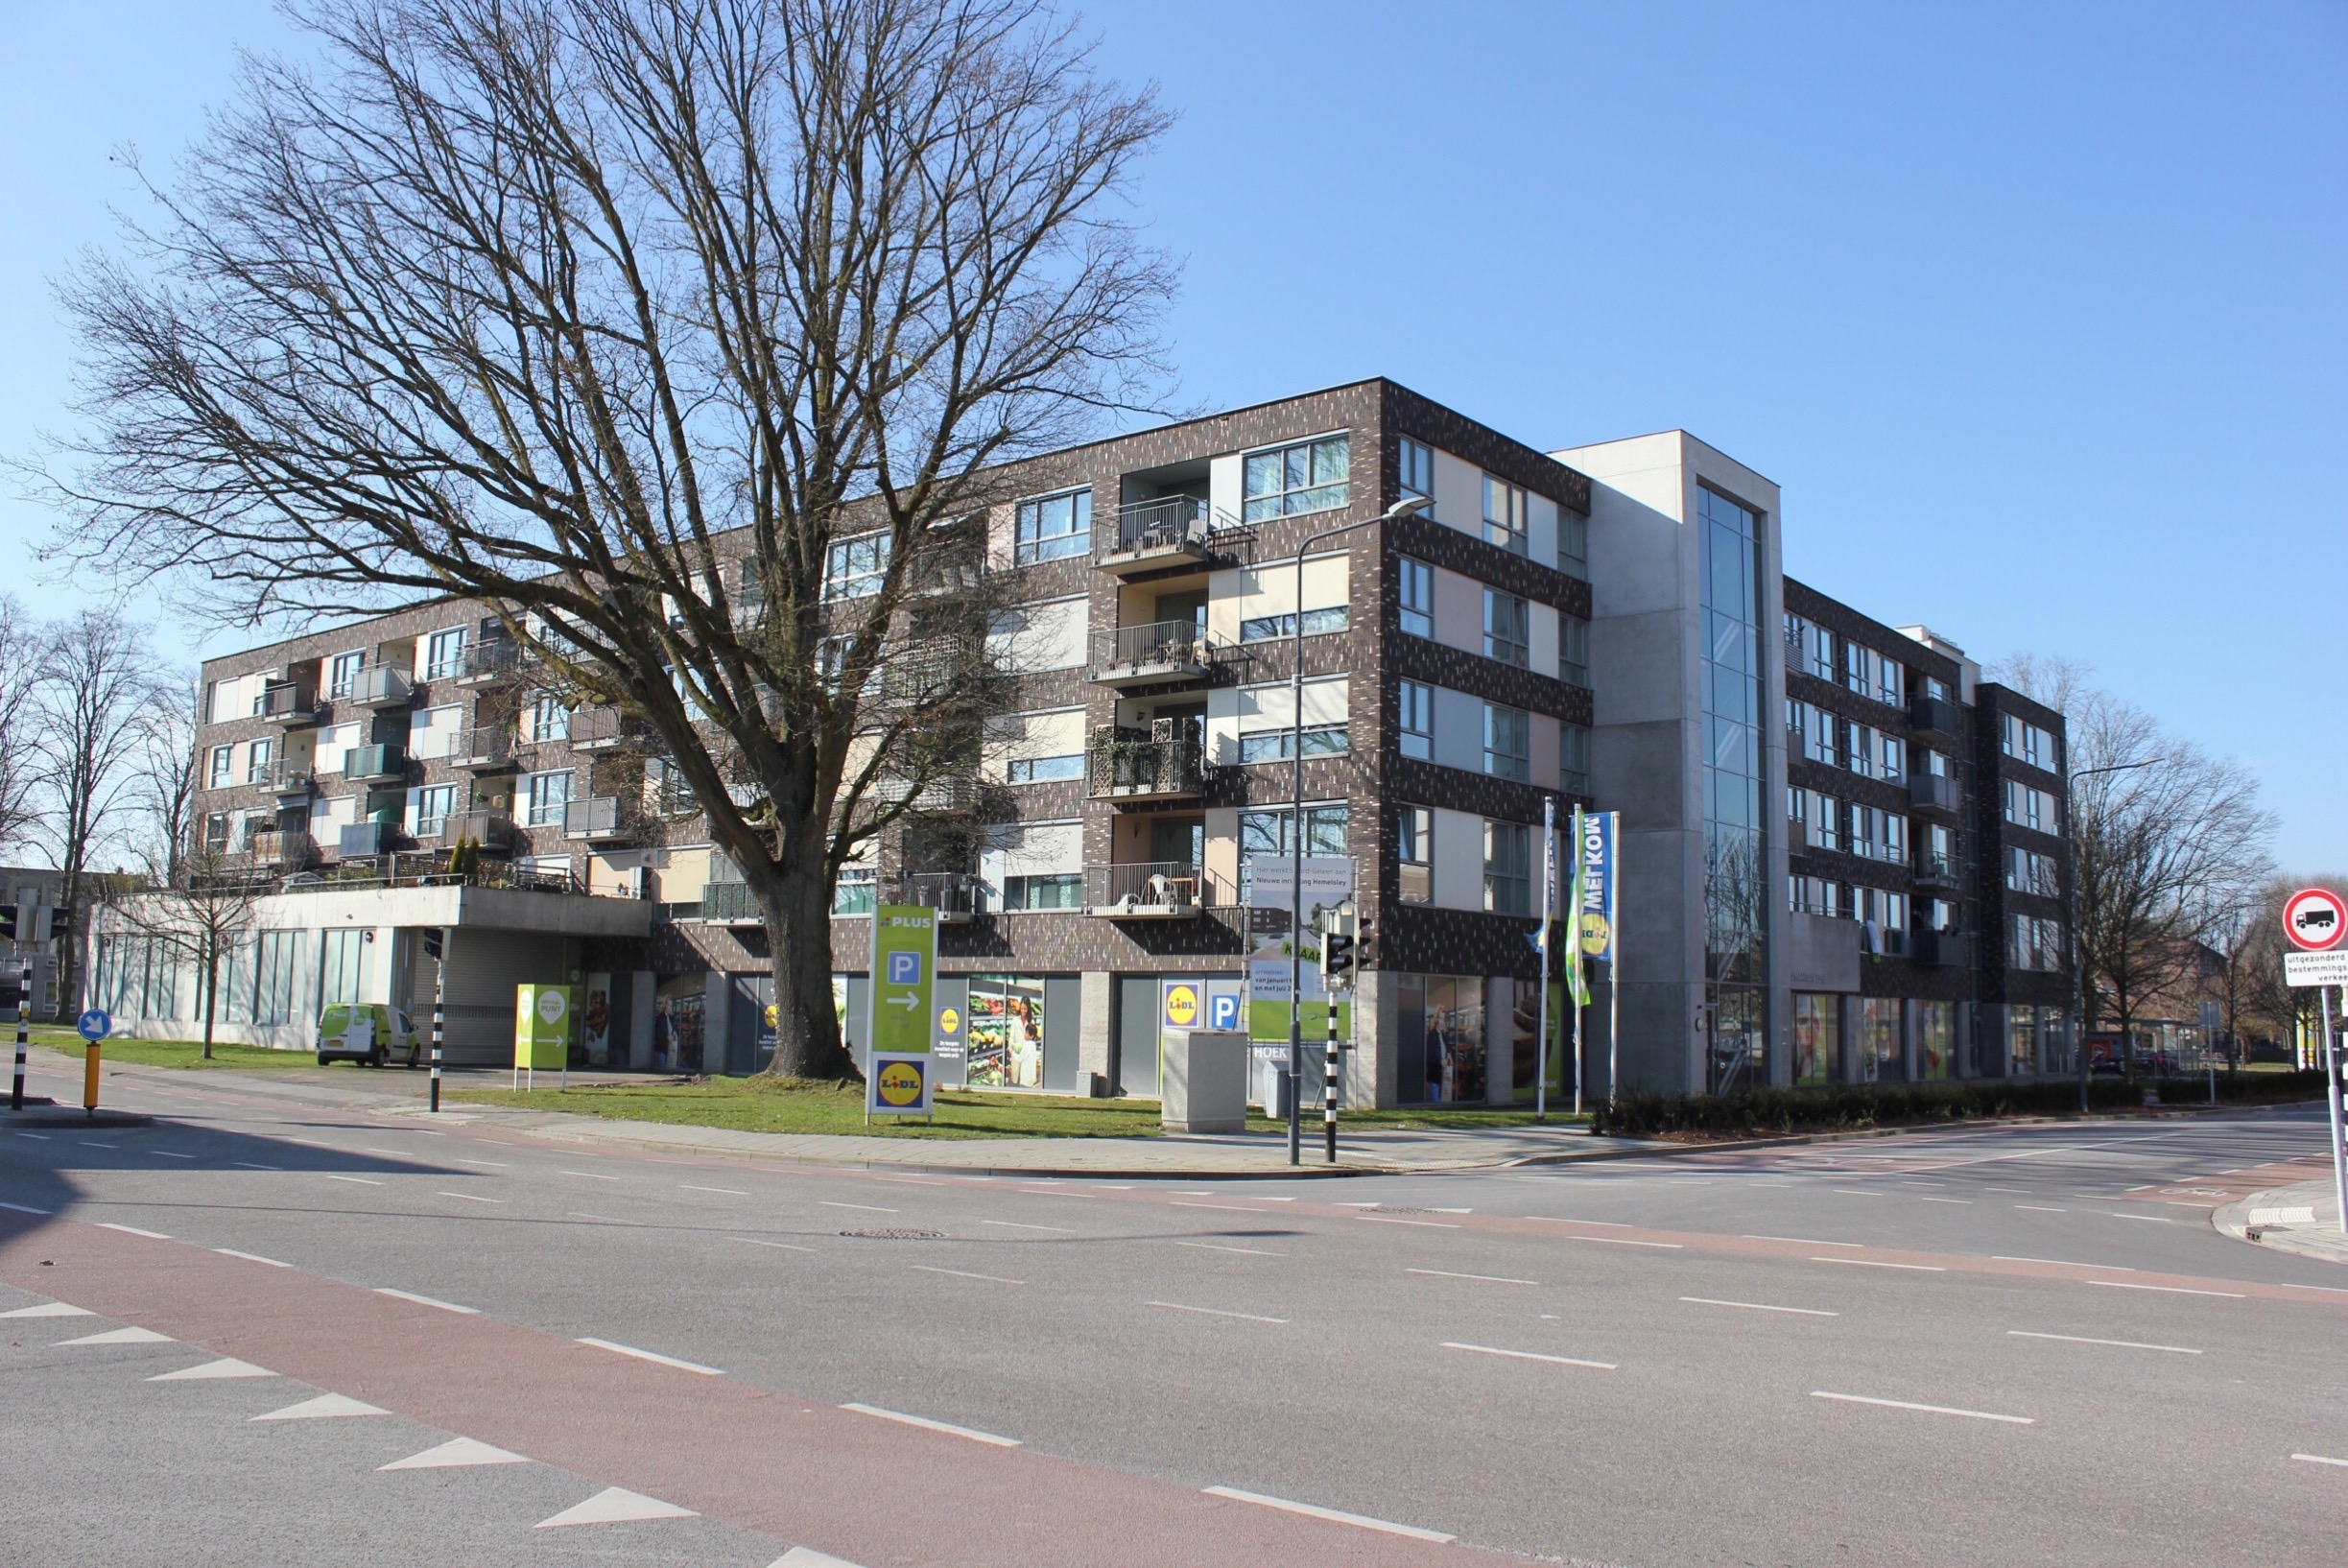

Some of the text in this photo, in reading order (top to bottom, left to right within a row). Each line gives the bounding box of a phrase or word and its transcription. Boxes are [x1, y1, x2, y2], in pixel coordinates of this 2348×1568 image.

[1290, 867, 1333, 875] Sard-Geleen
[1282, 877, 1312, 886] inriing
[1313, 878, 1347, 888] Hemelsley
[892, 916, 931, 928] PLUS
[1285, 943, 1321, 962] KAAR
[2287, 954, 2345, 963] uitgezonderd
[895, 956, 913, 981] P
[2288, 964, 2347, 973] bestemmings
[1216, 997, 1234, 1027] P
[1254, 1047, 1288, 1058] HOEK
